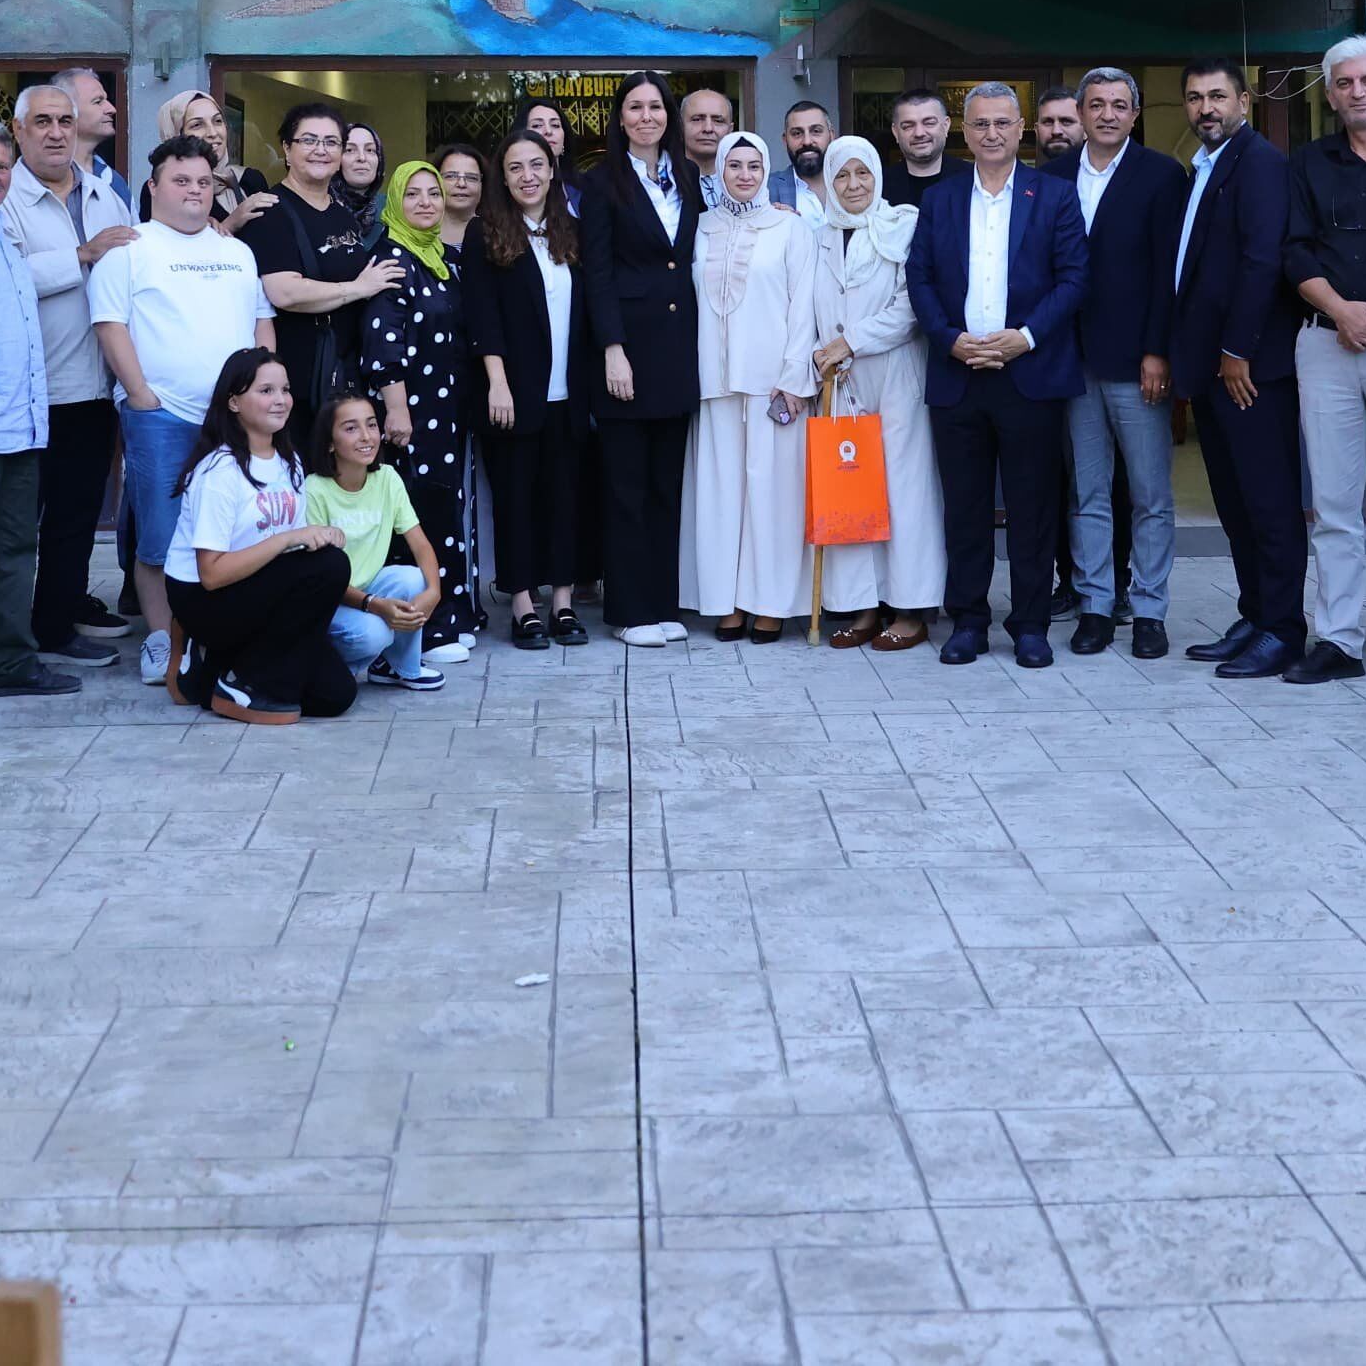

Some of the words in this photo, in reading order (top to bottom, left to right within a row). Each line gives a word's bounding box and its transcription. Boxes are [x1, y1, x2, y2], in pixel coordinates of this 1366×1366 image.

[555, 76, 623, 97] BAYBURT
[170, 263, 243, 272] UNWAVERING
[256, 491, 296, 530] SUN
